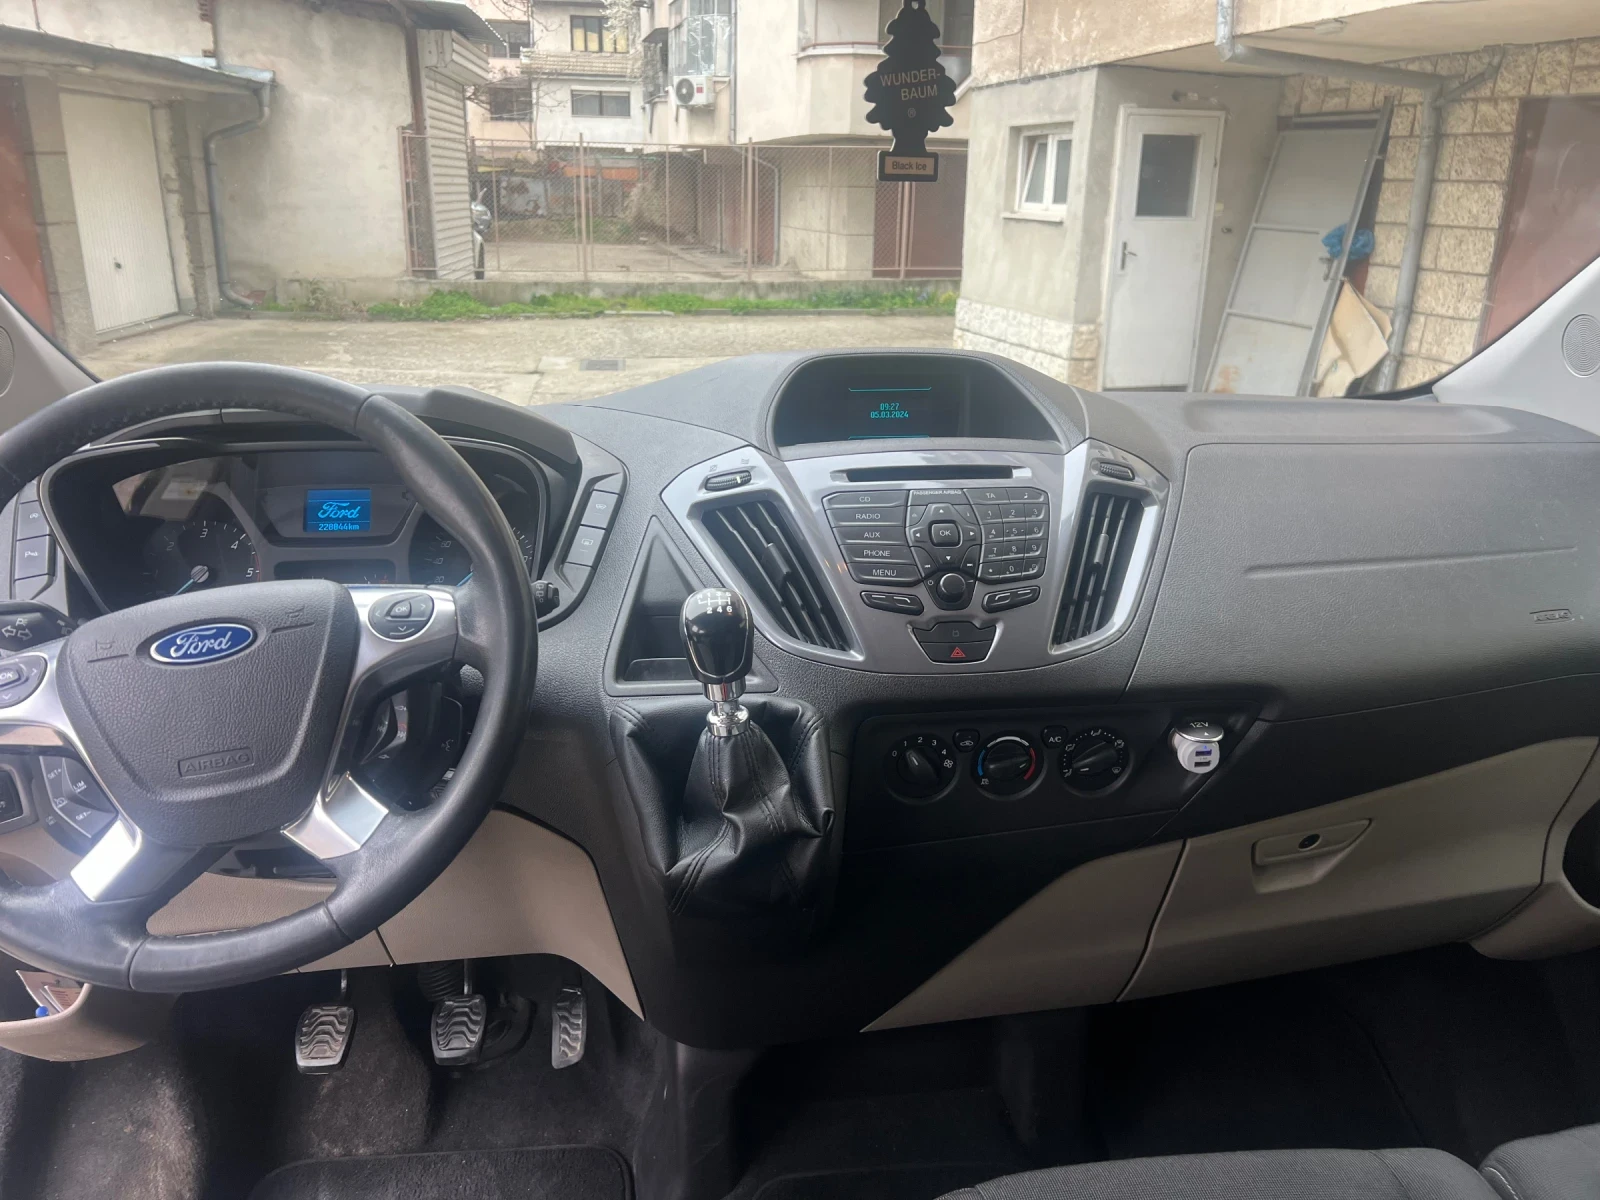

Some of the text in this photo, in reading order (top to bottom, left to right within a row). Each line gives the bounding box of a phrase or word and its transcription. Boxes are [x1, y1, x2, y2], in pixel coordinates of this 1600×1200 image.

[880, 68, 940, 87] WUNDER-
[901, 85, 938, 101] BAUM
[892, 161, 927, 171] Black Ice
[880, 403, 900, 411] 09:27
[870, 411, 909, 419] 05.03.2024
[318, 501, 361, 518] Ford
[200, 528, 209, 538] 3
[863, 531, 881, 539] AUX
[939, 529, 952, 537] OK
[166, 541, 175, 551] 2
[230, 540, 239, 550] 4
[863, 549, 891, 557] PHONE
[245, 567, 254, 577] 5
[872, 568, 897, 577] MENU
[395, 605, 408, 613] OK
[706, 605, 733, 614] 2 4 6
[170, 629, 232, 657] Ford
[0, 671, 13, 680] OK
[183, 753, 250, 773] AIRBAG
